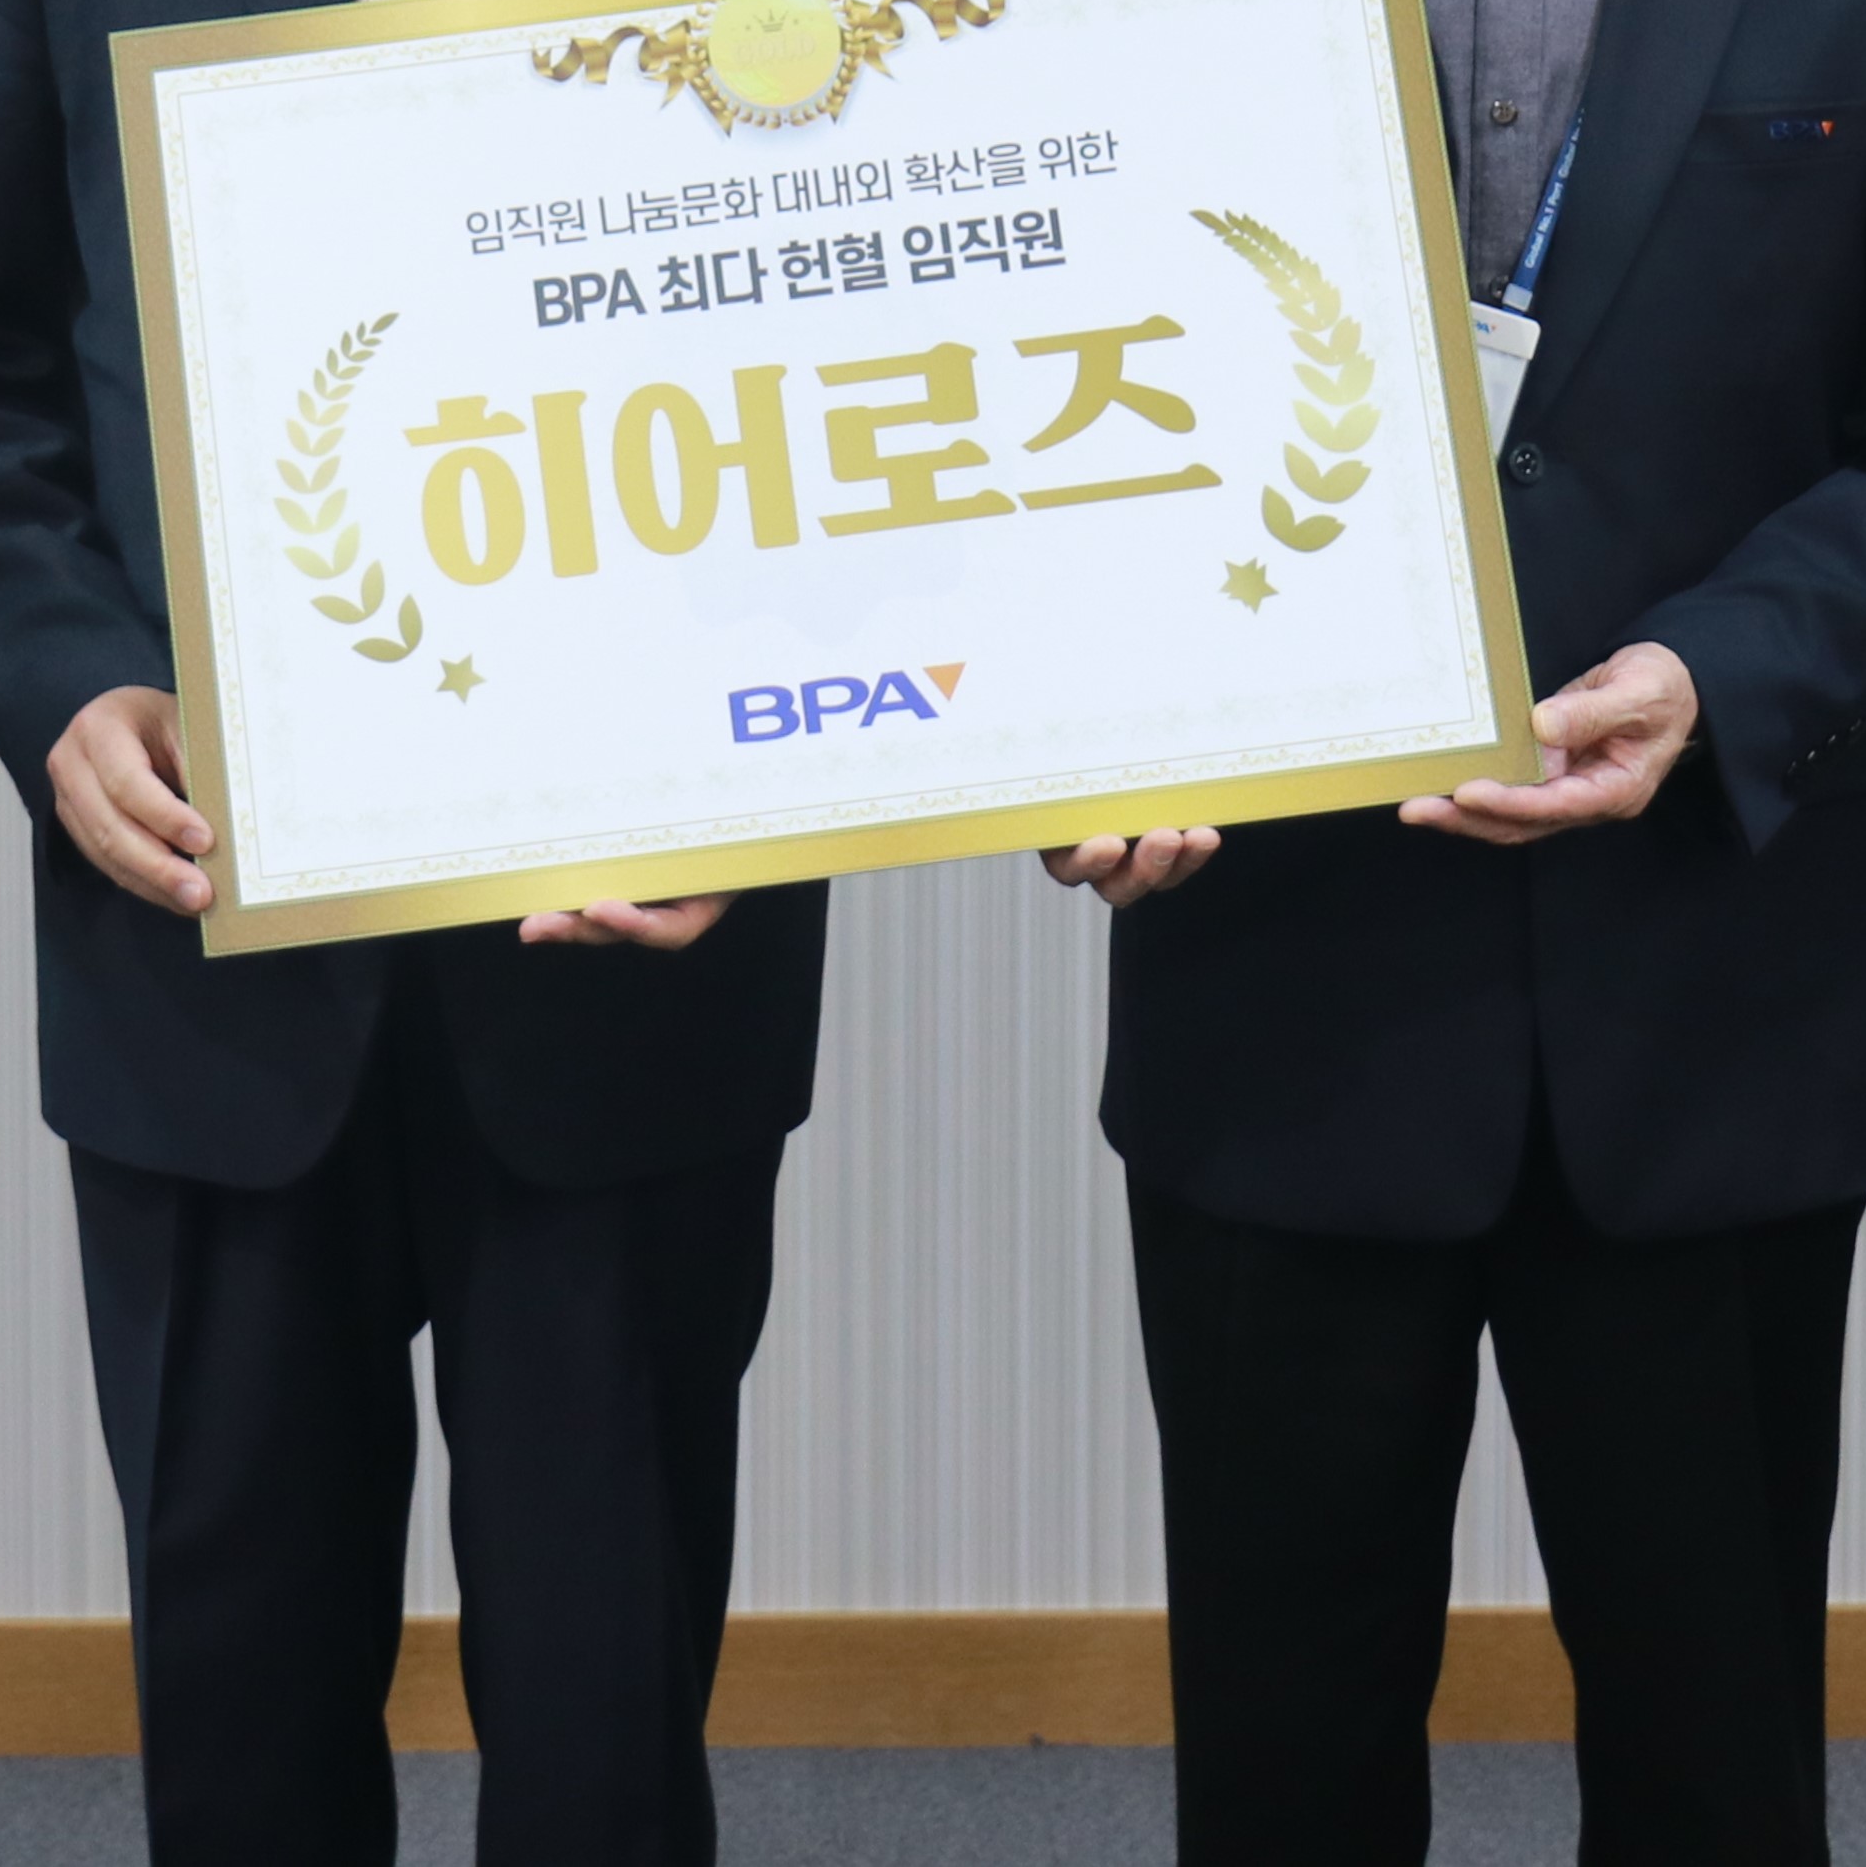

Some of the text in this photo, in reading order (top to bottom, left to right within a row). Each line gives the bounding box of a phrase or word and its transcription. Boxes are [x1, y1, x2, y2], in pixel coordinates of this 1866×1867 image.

[466, 130, 1120, 255] 임직원 나눔문화 대내외 확산을 위한
[533, 207, 1068, 328] BPA 최다 헌혈 임직원
[403, 314, 1224, 587] 히어로즈
[727, 670, 941, 745] BPA
